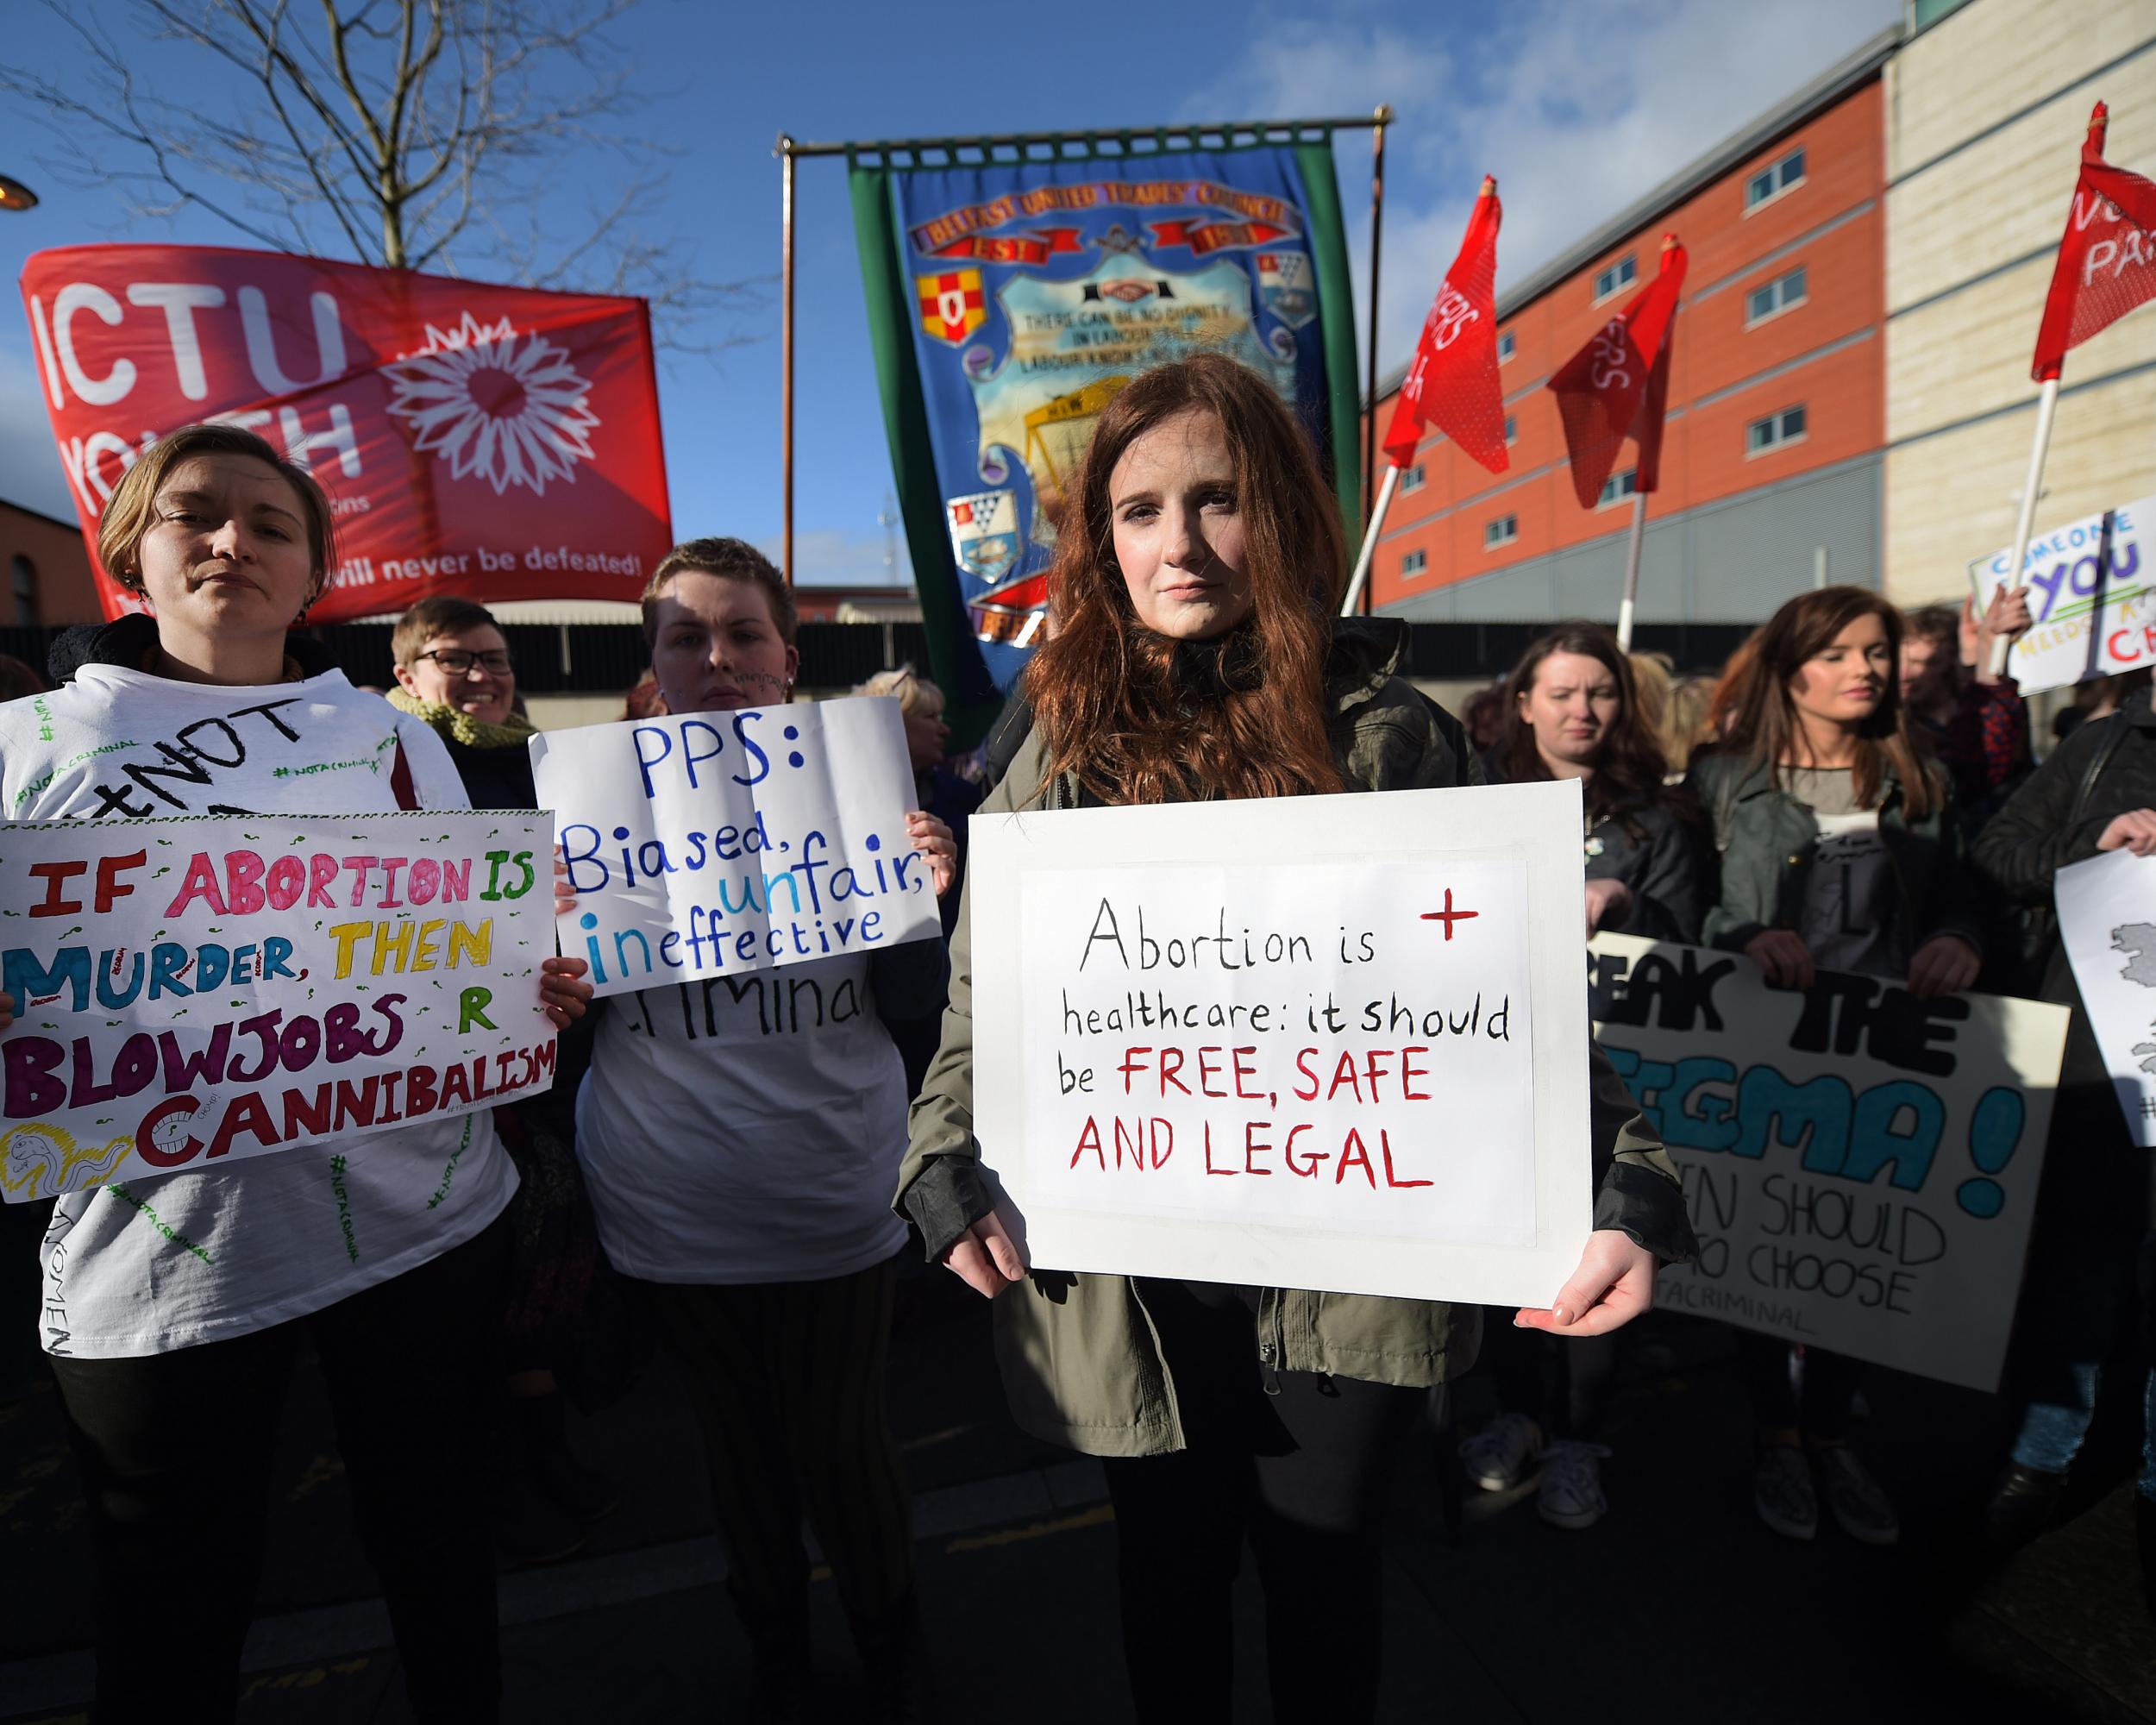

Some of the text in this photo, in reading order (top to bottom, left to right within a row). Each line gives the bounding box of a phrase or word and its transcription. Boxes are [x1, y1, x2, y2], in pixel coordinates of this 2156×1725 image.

[928, 199, 1015, 244] BELFAST
[1022, 185, 1097, 215] UNITED
[30, 282, 346, 411] ICTU
[60, 402, 363, 518] YOTH
[383, 553, 468, 581] never
[478, 547, 516, 573] be
[524, 545, 642, 578] defeated!
[2030, 542, 2140, 623] YOU
[632, 712, 805, 800] PPS:
[28, 849, 535, 919] IF ABORTION IS
[560, 811, 789, 894] Biased,
[718, 831, 924, 915] unfair,
[2, 917, 494, 1019] MURDER, THEN
[580, 906, 884, 985] ineffective
[1079, 897, 1376, 973] Abortion is
[1, 986, 498, 1120] BLOWJOBS R
[1062, 988, 1510, 1041] healthcare: it should
[1764, 968, 1971, 1077] THE
[135, 1038, 556, 1168] CANNIBALISM
[1058, 1045, 1434, 1112] be FREE, SAFE
[1069, 1114, 1435, 1190] AND LEGAL
[1760, 1174, 1946, 1265] SHOULD
[1747, 1244, 1918, 1315] CHOOSE
